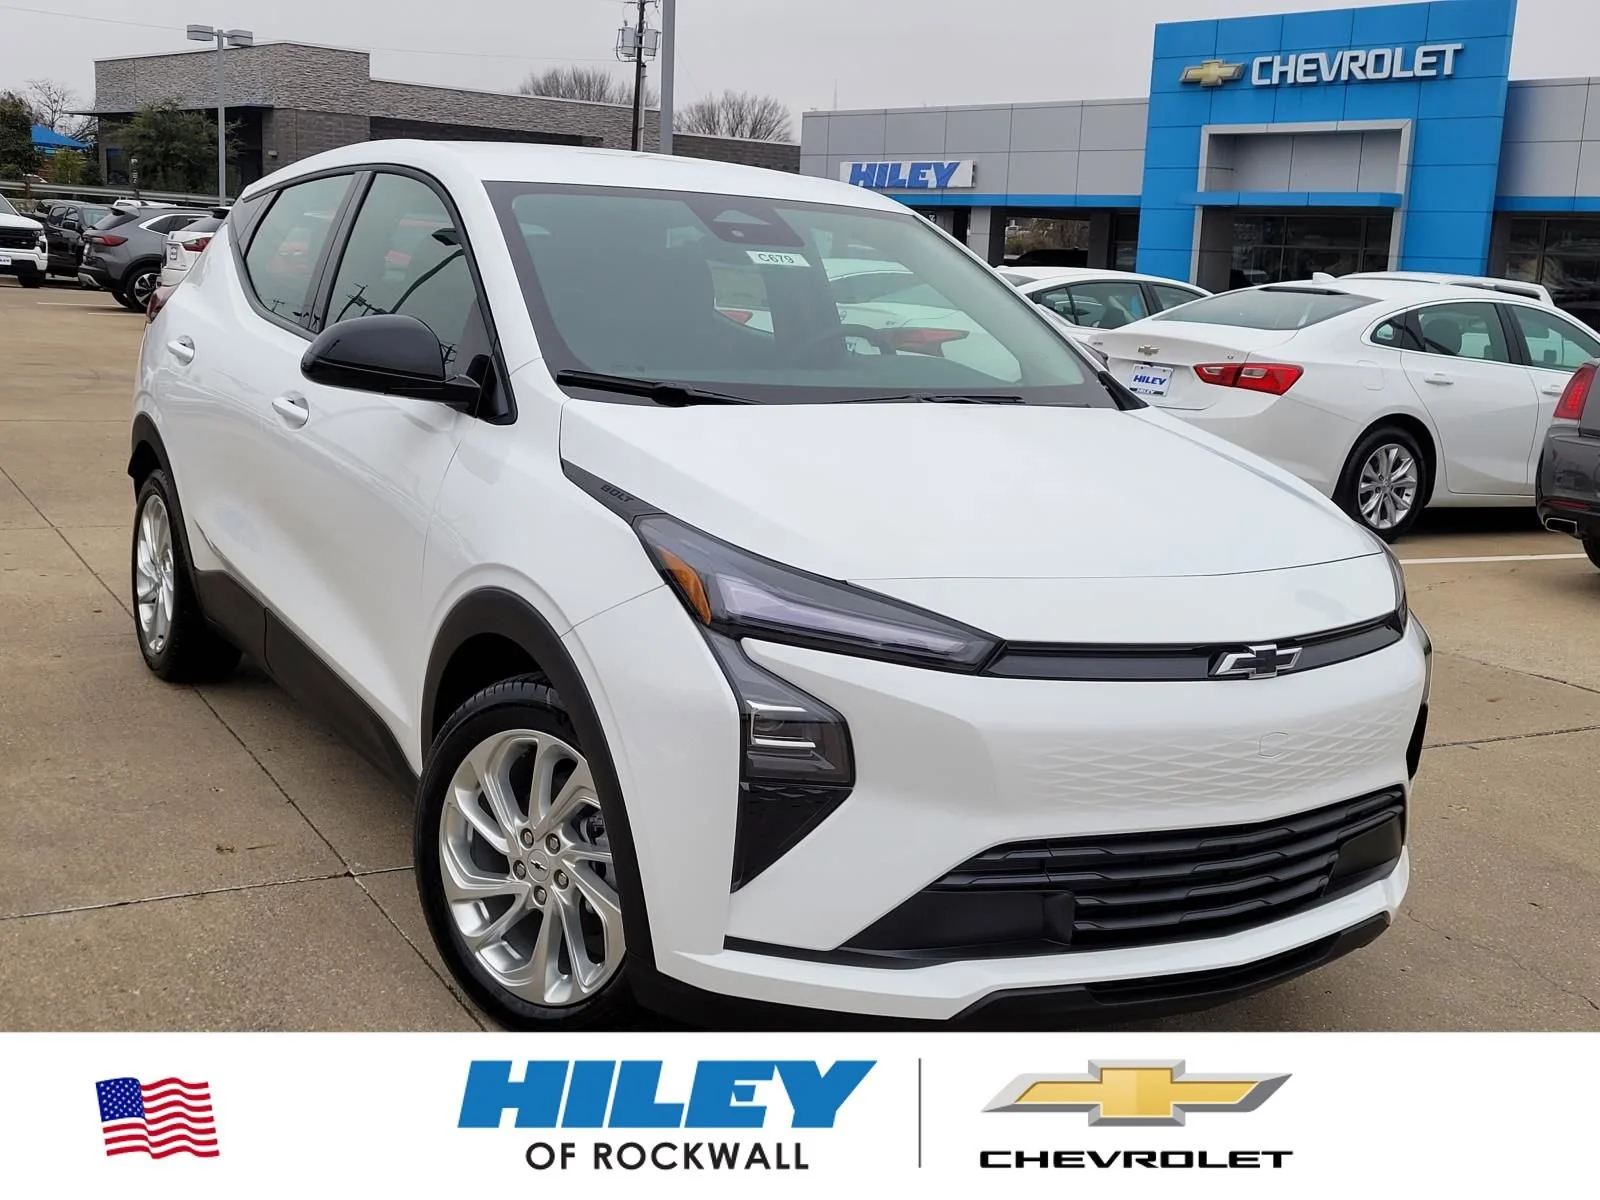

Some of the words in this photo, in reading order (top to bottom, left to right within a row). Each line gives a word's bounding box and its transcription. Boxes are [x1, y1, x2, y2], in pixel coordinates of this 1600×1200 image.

[1252, 43, 1463, 86] CHEVROLET
[848, 162, 960, 188] HILEY
[758, 253, 795, 264] C679
[1133, 374, 1167, 386] HILEY
[600, 484, 634, 502] BOLT
